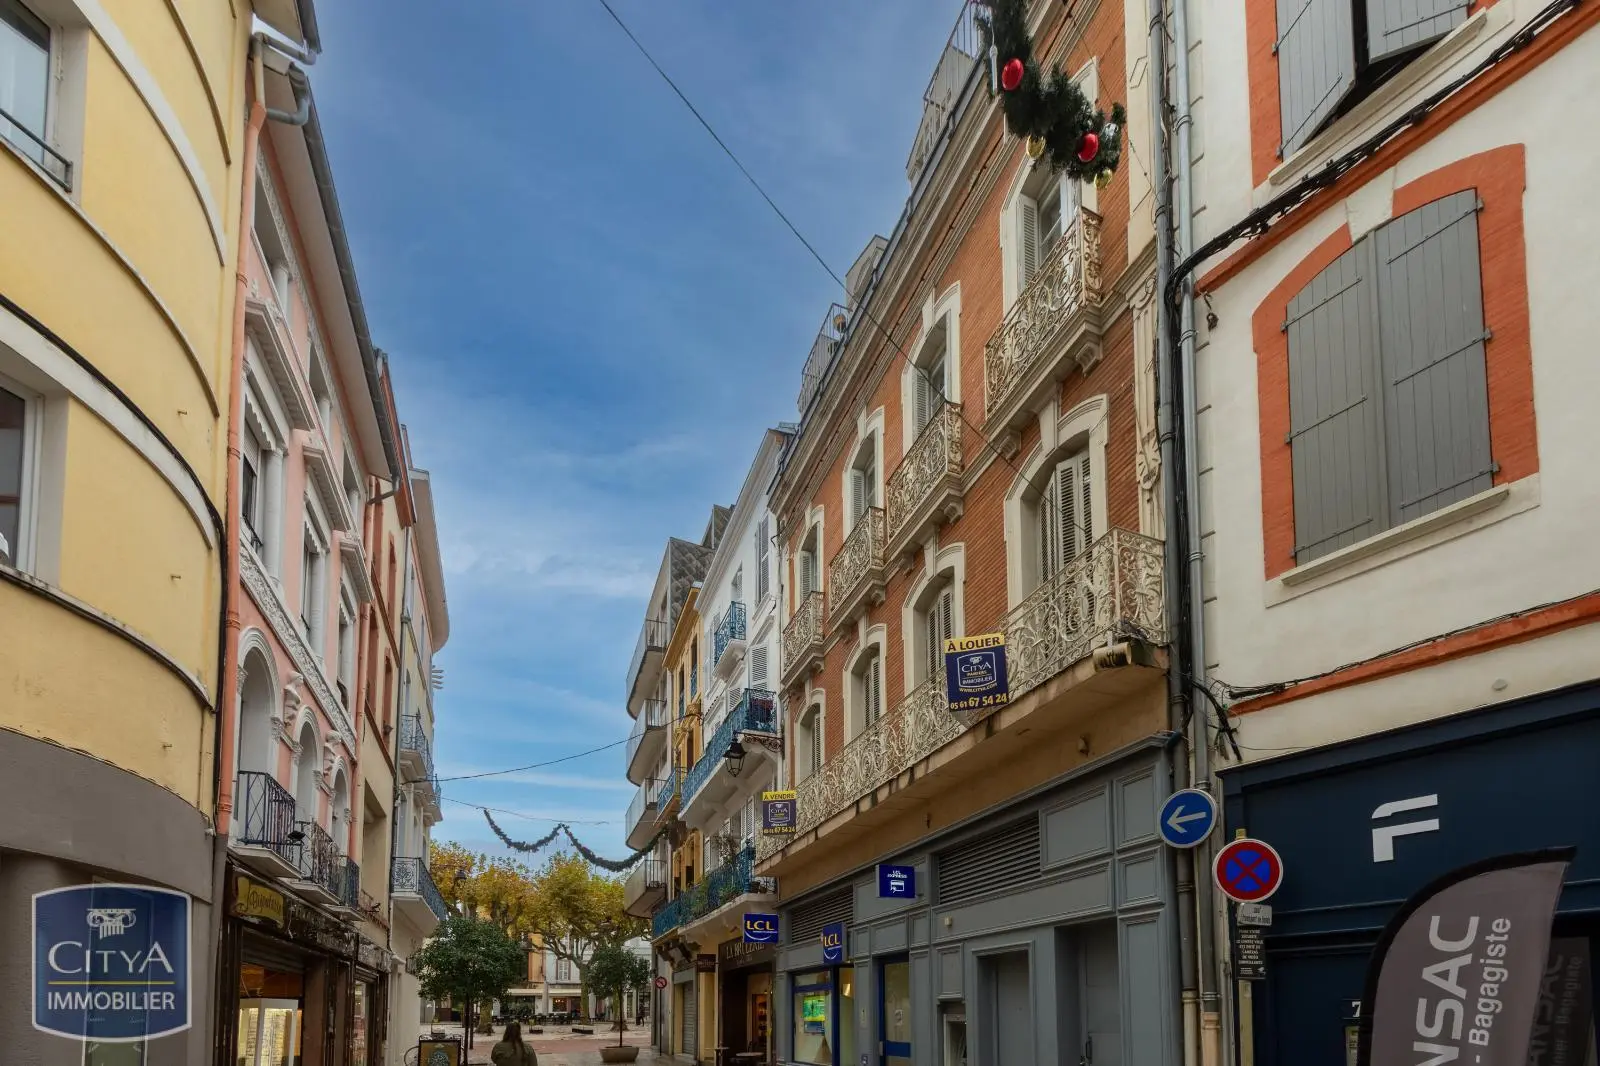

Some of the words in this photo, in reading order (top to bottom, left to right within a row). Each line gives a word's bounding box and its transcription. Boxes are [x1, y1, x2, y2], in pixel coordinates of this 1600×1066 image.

[948, 640, 956, 651] À
[960, 637, 1000, 650] LOUER
[962, 662, 992, 672] CITYA
[969, 697, 979, 707] 67
[982, 696, 993, 706] 54
[996, 693, 1007, 704] 24
[746, 920, 775, 931] LCL
[824, 933, 840, 947] LCL
[1468, 918, 1511, 1046] Bagagiste
[1352, 1001, 1361, 1018] 7
